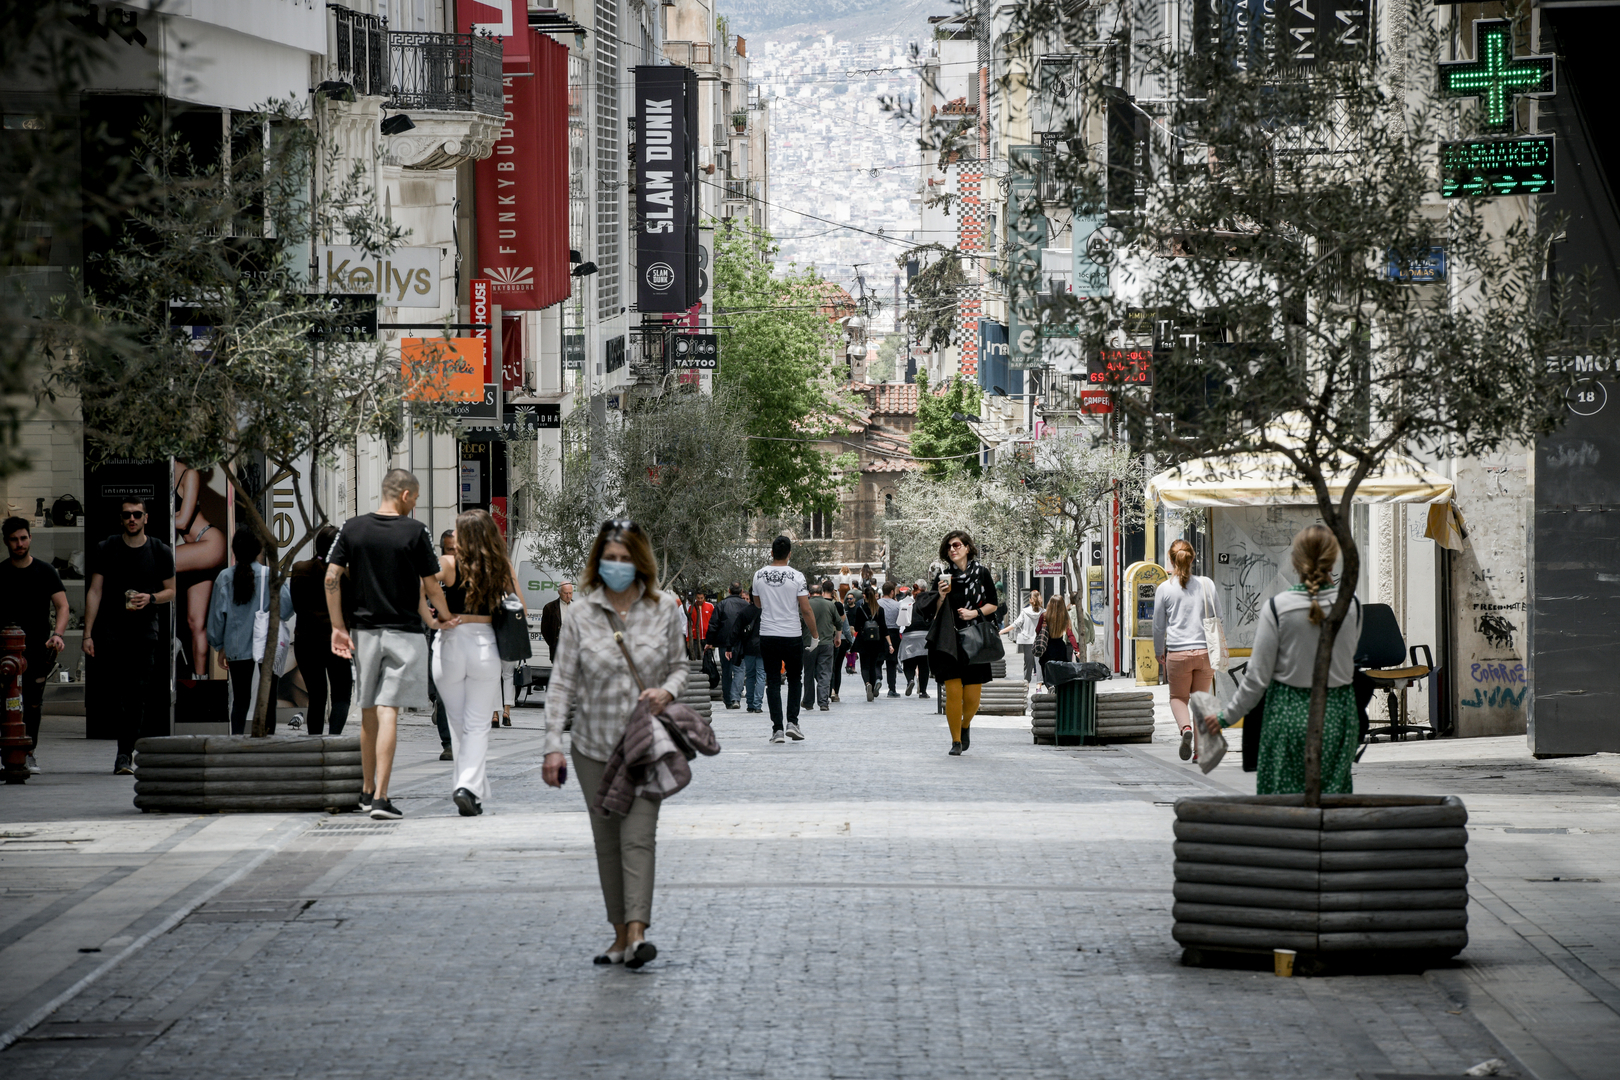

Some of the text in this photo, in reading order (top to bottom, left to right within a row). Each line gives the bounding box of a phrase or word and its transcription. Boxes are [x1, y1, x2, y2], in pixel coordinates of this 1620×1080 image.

[646, 99, 674, 234] SLAM DUNK
[1083, 397, 1110, 406] CAMPER
[1577, 391, 1596, 402] 18
